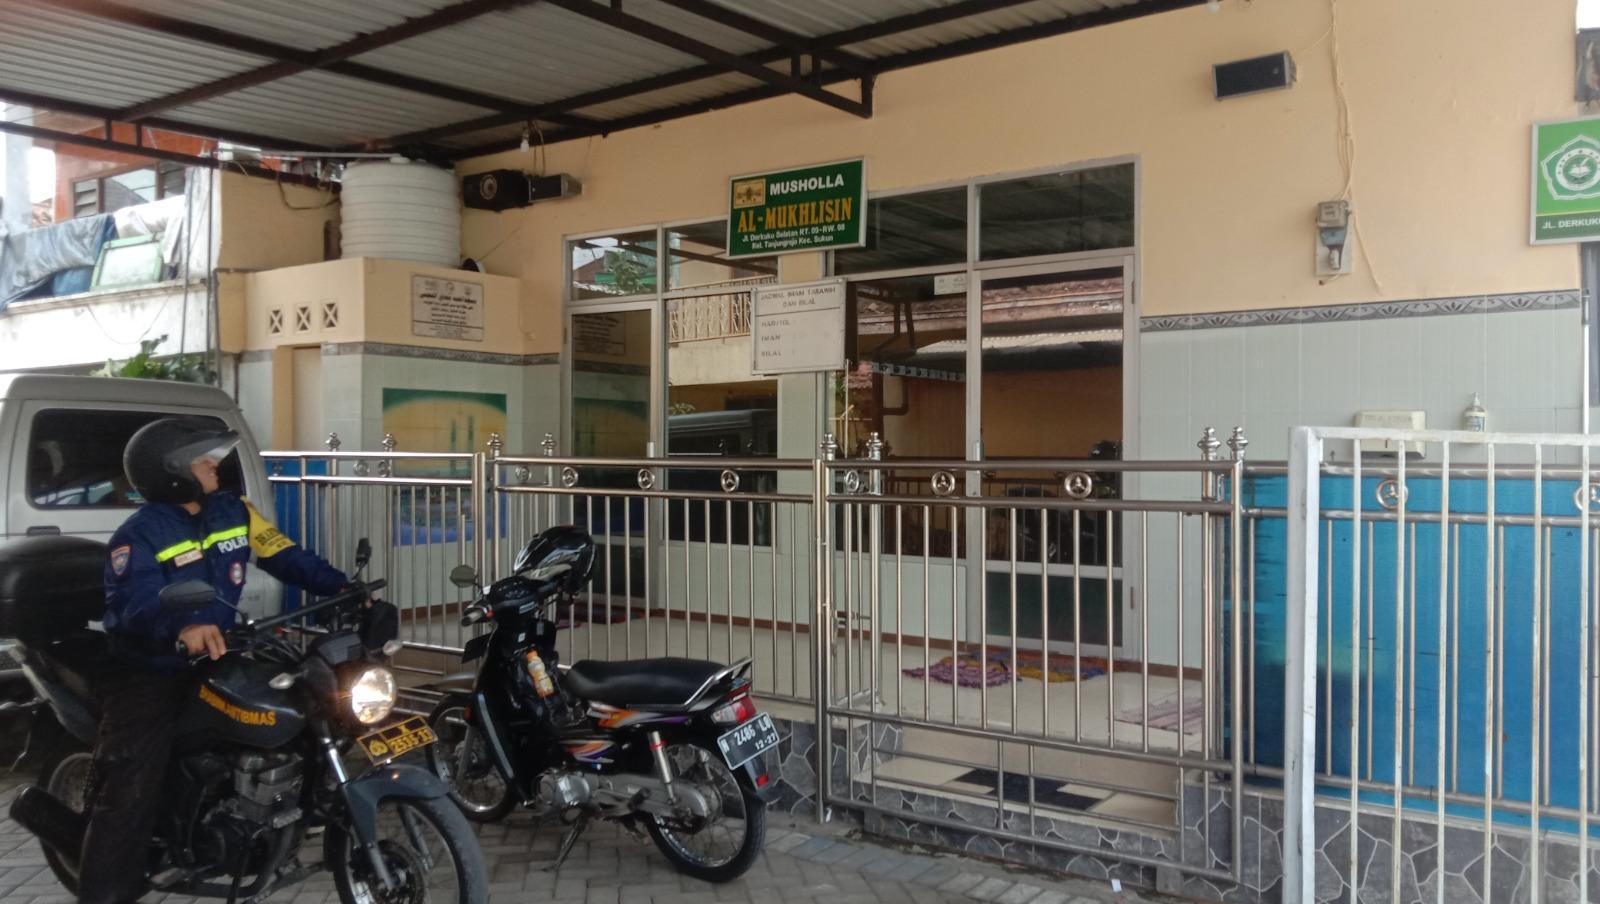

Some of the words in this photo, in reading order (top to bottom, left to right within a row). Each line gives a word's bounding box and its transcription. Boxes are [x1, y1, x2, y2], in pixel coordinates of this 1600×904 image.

[770, 173, 844, 196] MUSHOLLA
[738, 197, 852, 233] AL-MUKHLISIN
[750, 233, 775, 242] Derkuku
[776, 230, 798, 239] Selatan
[799, 236, 812, 245] Kec.
[814, 235, 834, 243] Sukun
